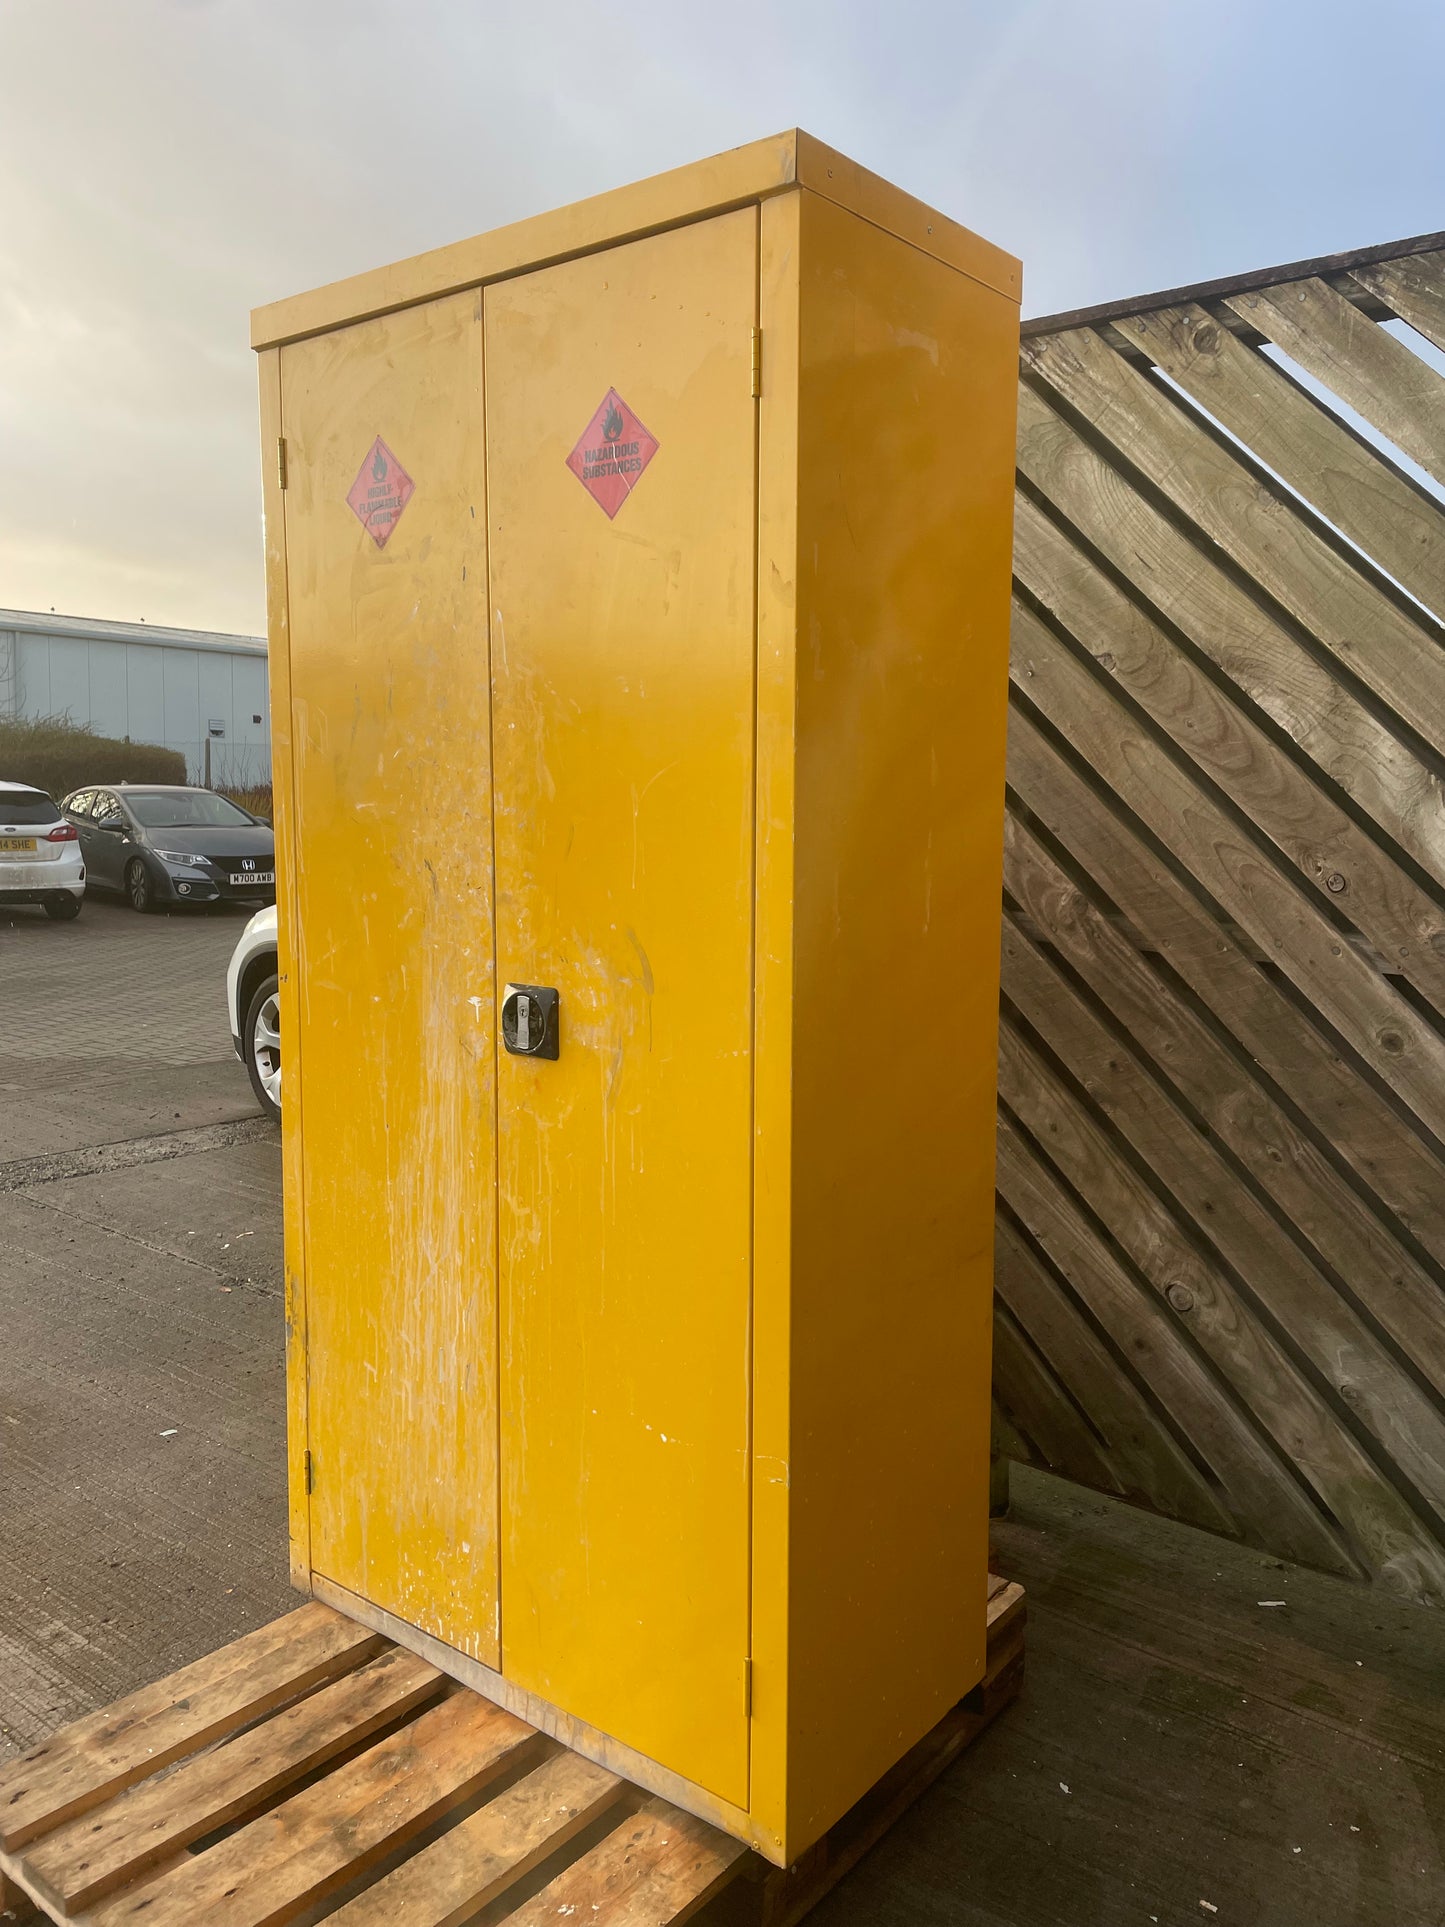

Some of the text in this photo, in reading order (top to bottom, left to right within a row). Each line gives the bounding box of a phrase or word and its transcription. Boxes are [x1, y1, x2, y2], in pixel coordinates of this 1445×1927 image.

[585, 441, 639, 464] HAZARDOUS
[582, 457, 642, 480] SUBSTANCES
[359, 495, 402, 515] FLAMMABLE
[11, 839, 31, 849] SHE
[233, 874, 255, 883] M700
